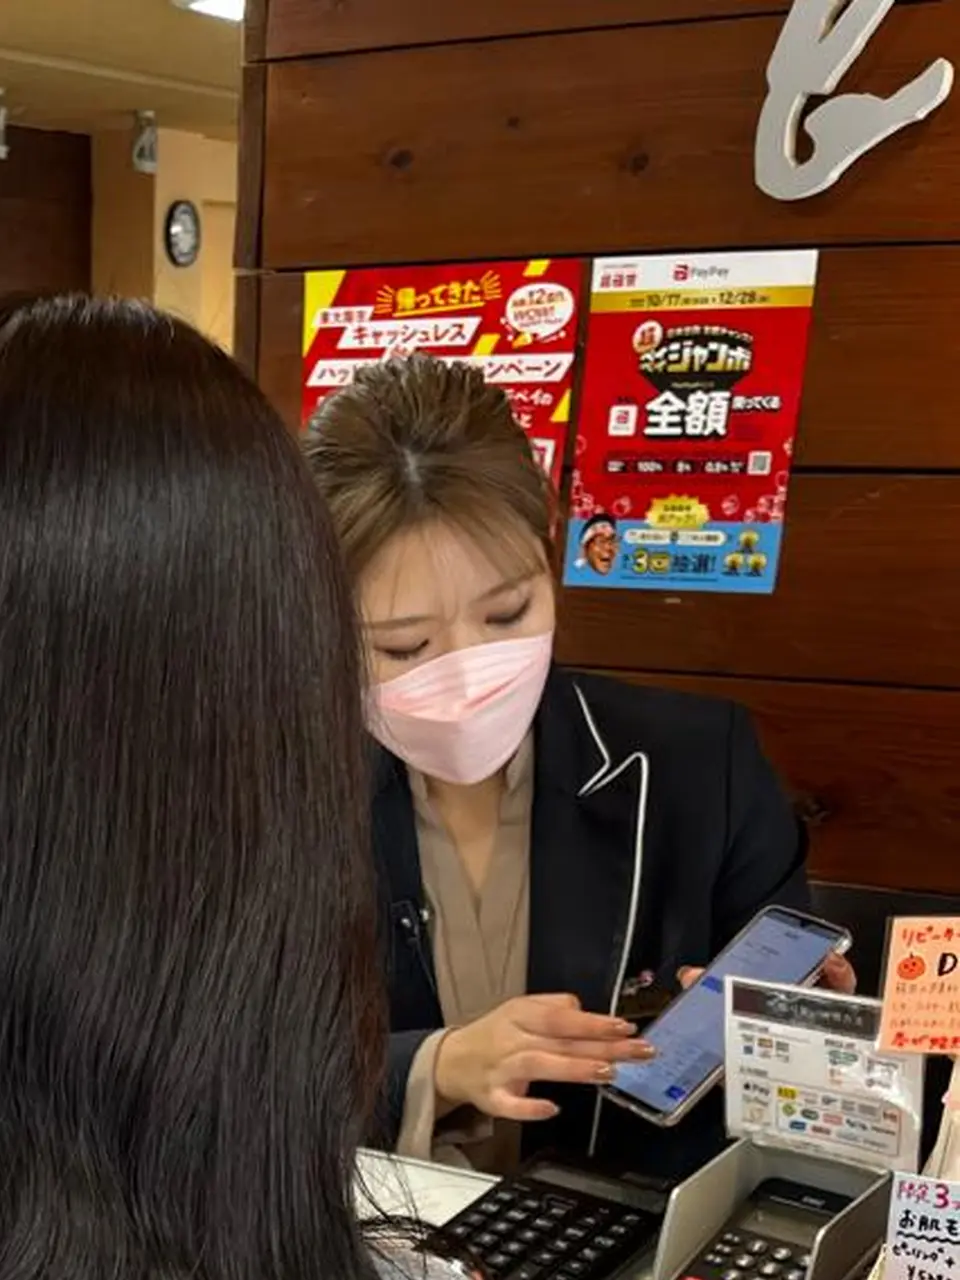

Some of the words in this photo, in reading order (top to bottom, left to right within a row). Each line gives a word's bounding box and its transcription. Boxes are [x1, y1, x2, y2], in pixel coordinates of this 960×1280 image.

[352, 322, 468, 347] キャッシュレス
[644, 390, 732, 437] 全額
